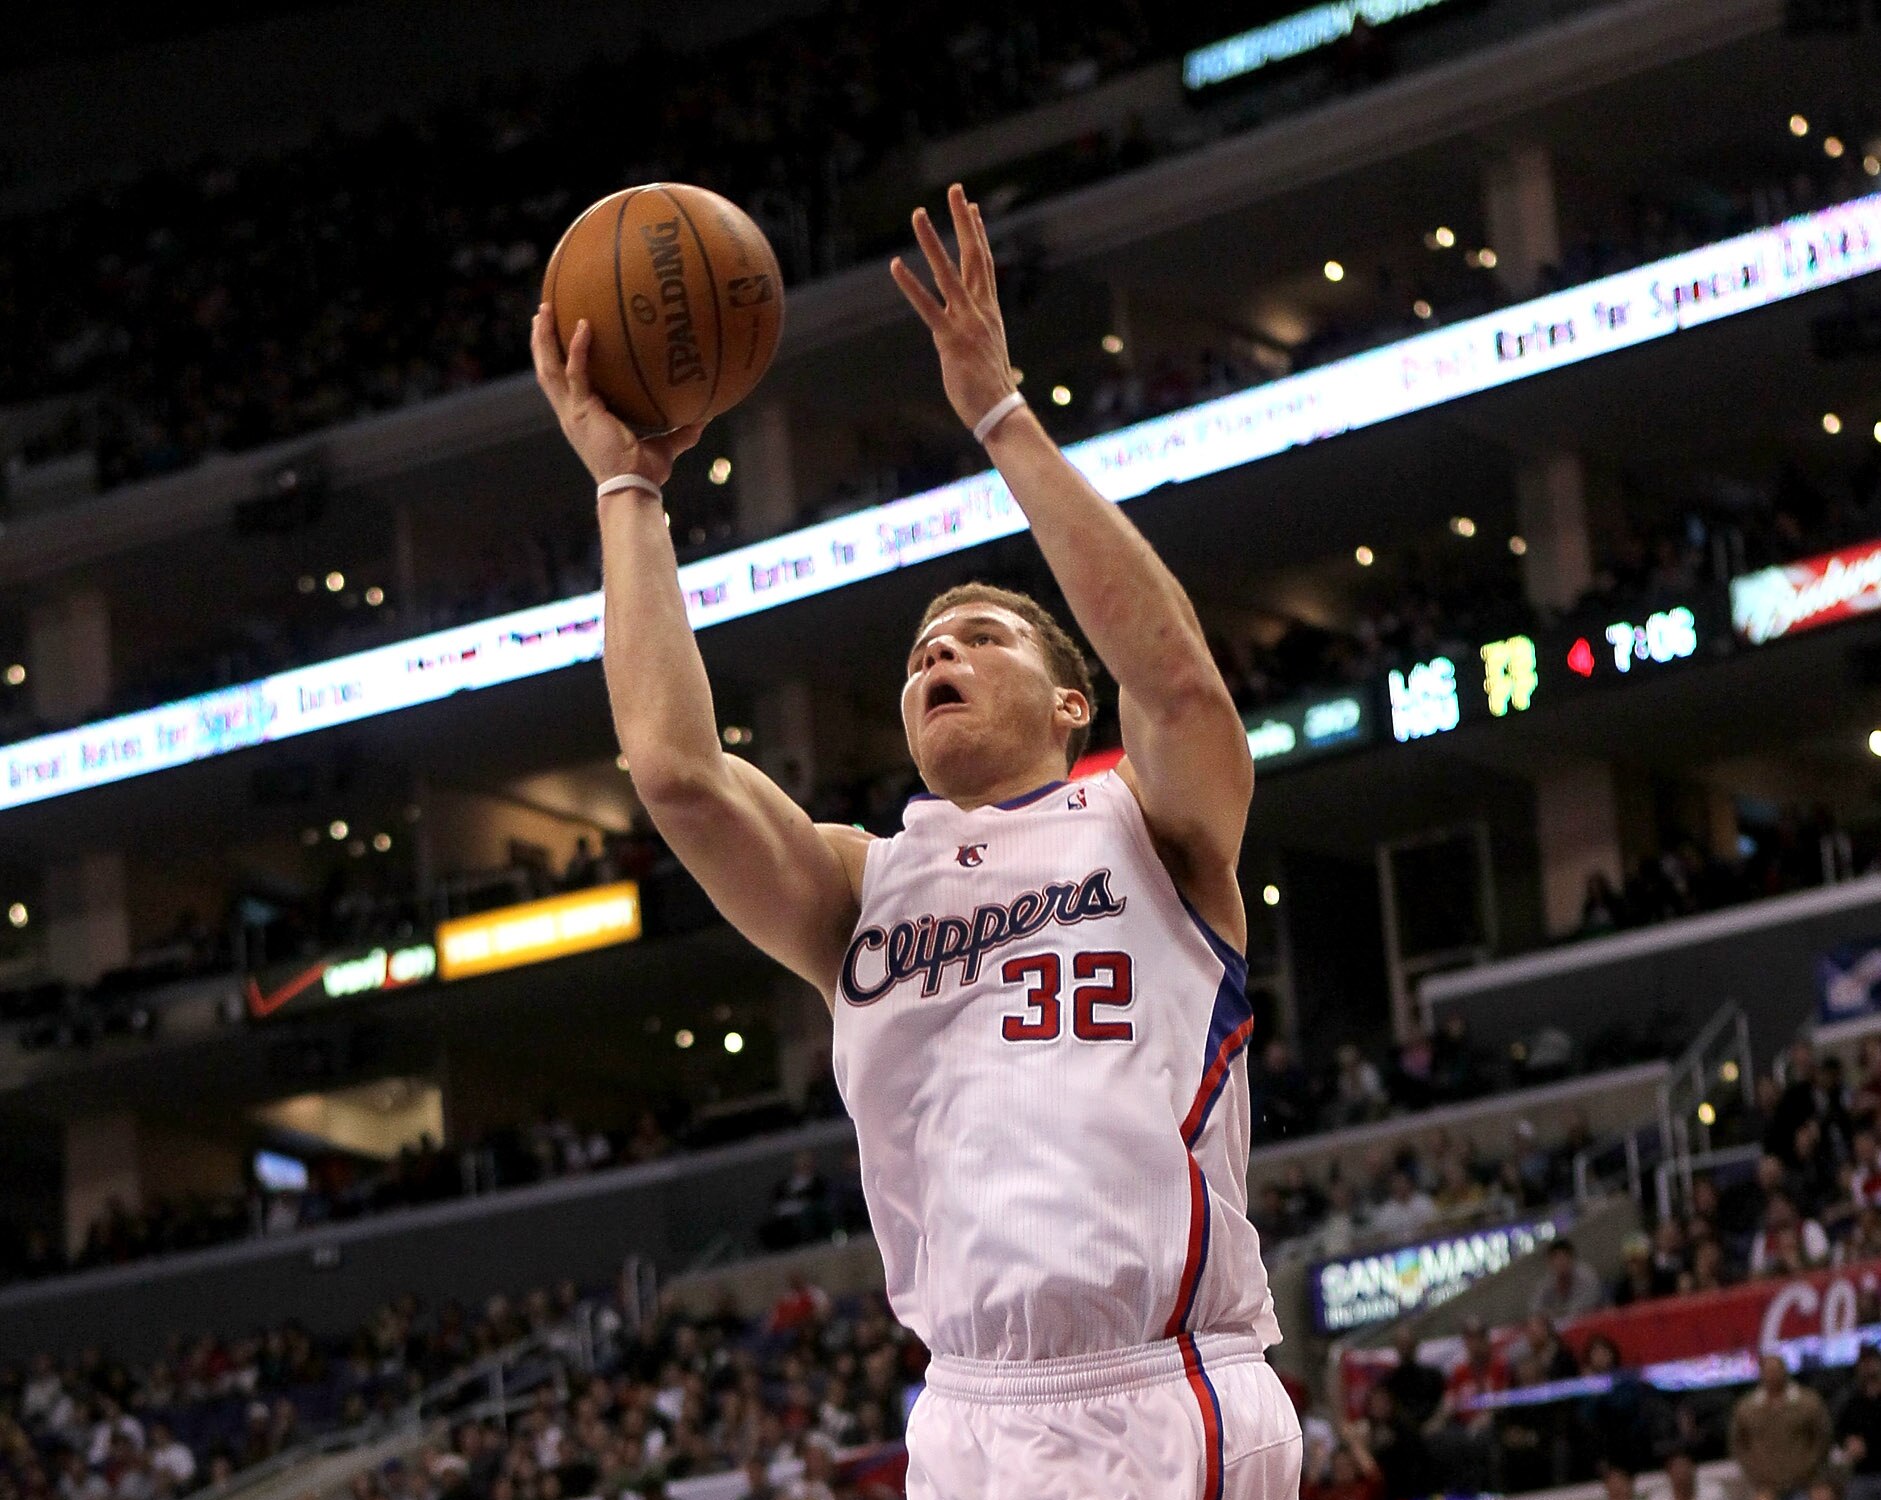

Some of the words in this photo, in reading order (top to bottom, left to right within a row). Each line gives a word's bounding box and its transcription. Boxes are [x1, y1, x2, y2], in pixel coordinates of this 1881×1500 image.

[641, 217, 708, 387] SPALDING
[840, 868, 1127, 1007] Clippers
[1000, 951, 1136, 1043] 32
